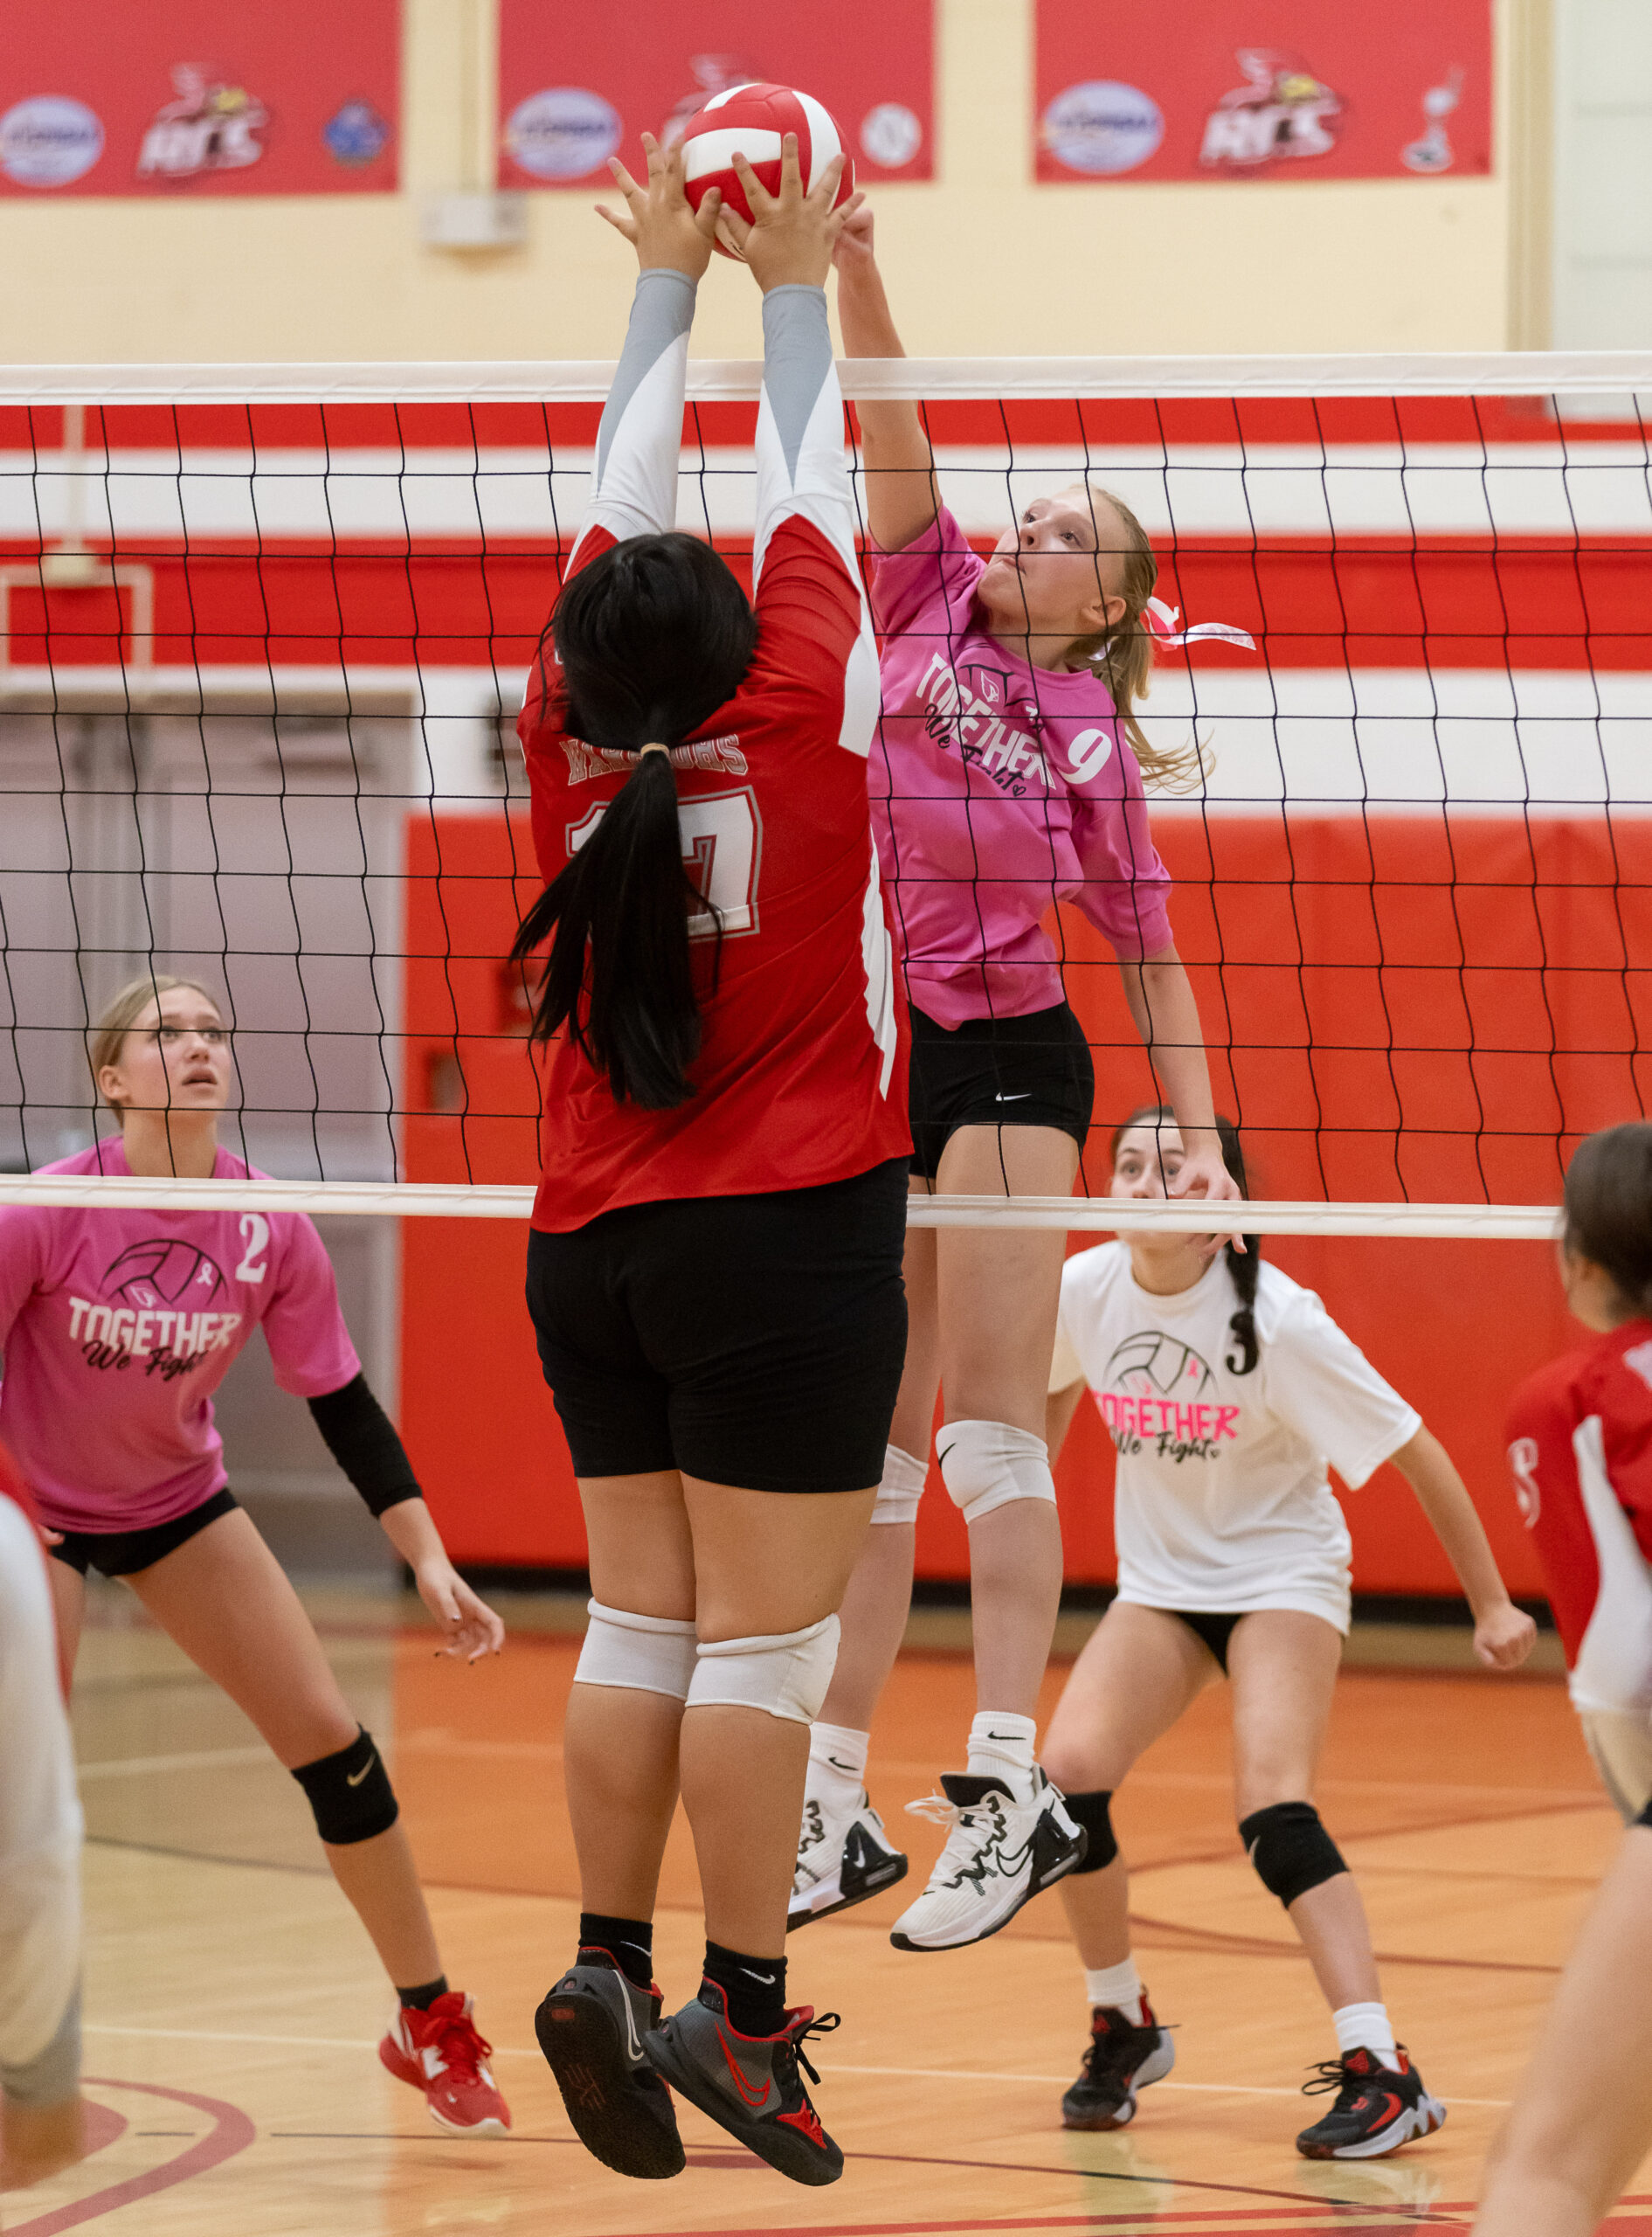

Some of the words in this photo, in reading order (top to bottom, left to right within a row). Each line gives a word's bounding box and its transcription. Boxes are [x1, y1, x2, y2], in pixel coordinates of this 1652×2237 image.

[1060, 728, 1112, 785] 9
[235, 1213, 270, 1283] 2
[82, 1339, 131, 1370] We
